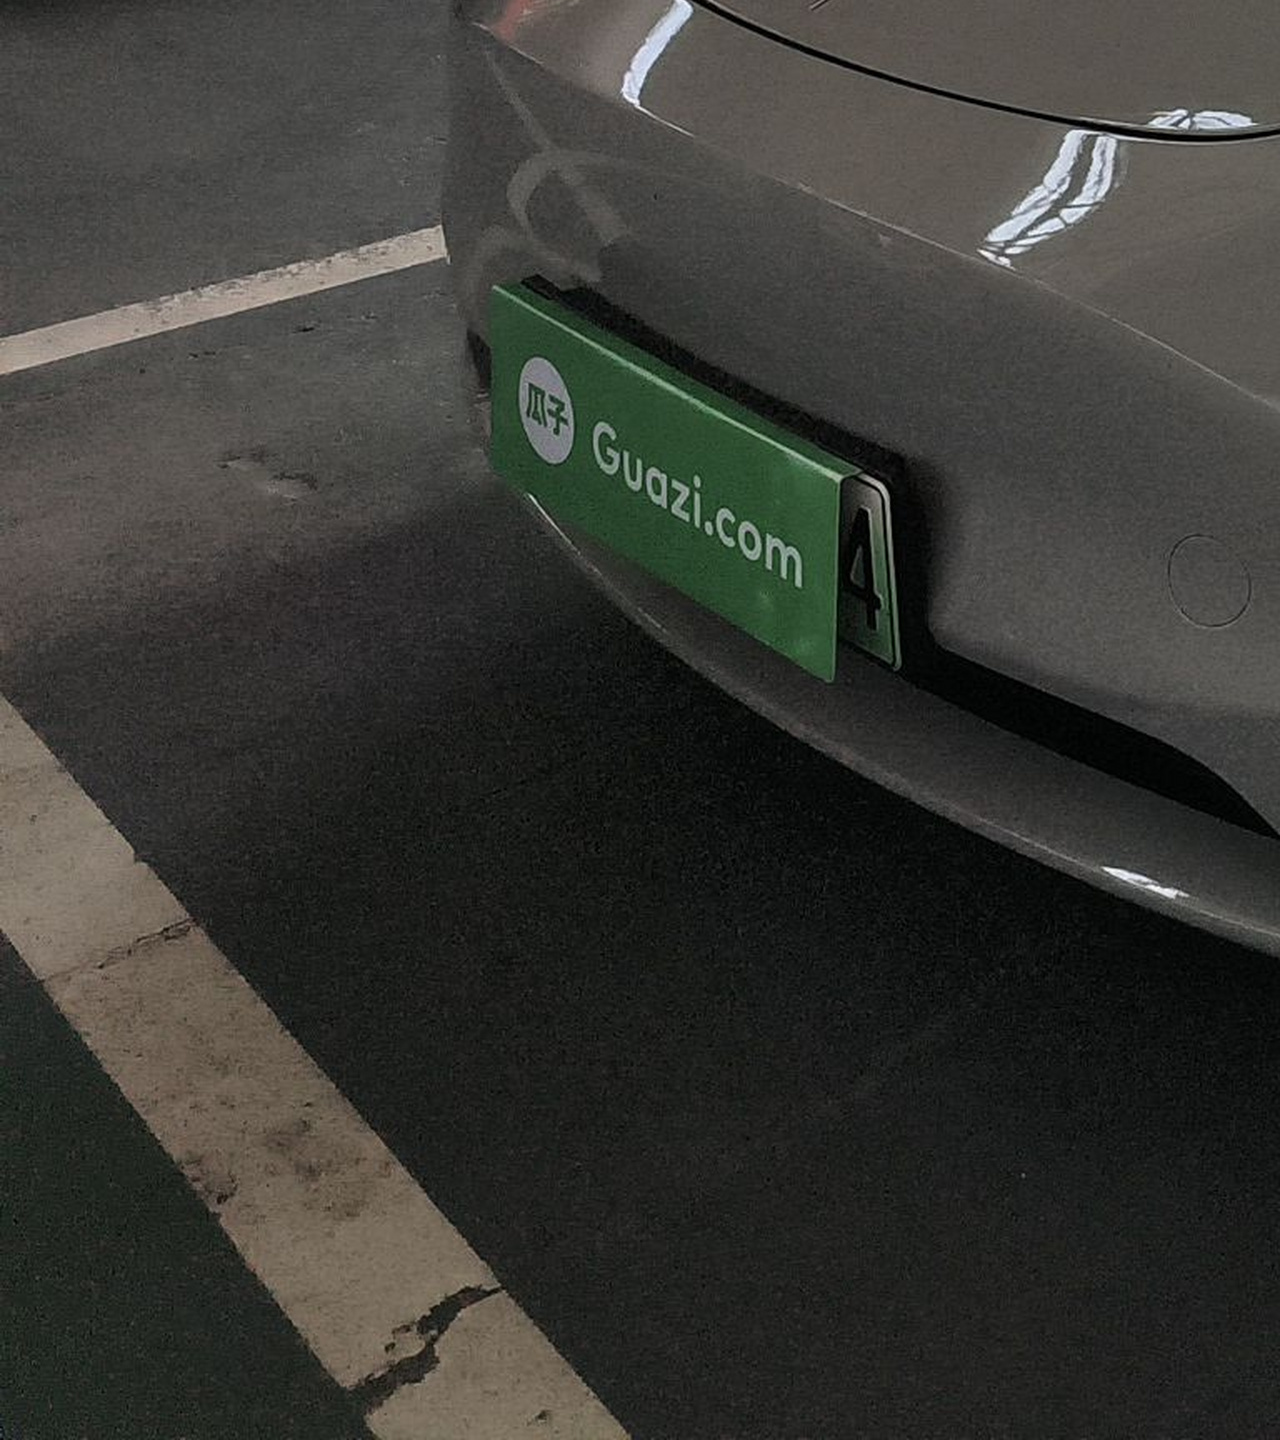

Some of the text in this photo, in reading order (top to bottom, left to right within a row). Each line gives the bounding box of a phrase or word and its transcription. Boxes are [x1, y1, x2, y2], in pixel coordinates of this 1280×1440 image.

[526, 382, 802, 589] 瓜子 Guazi.com
[848, 506, 881, 631] 4
